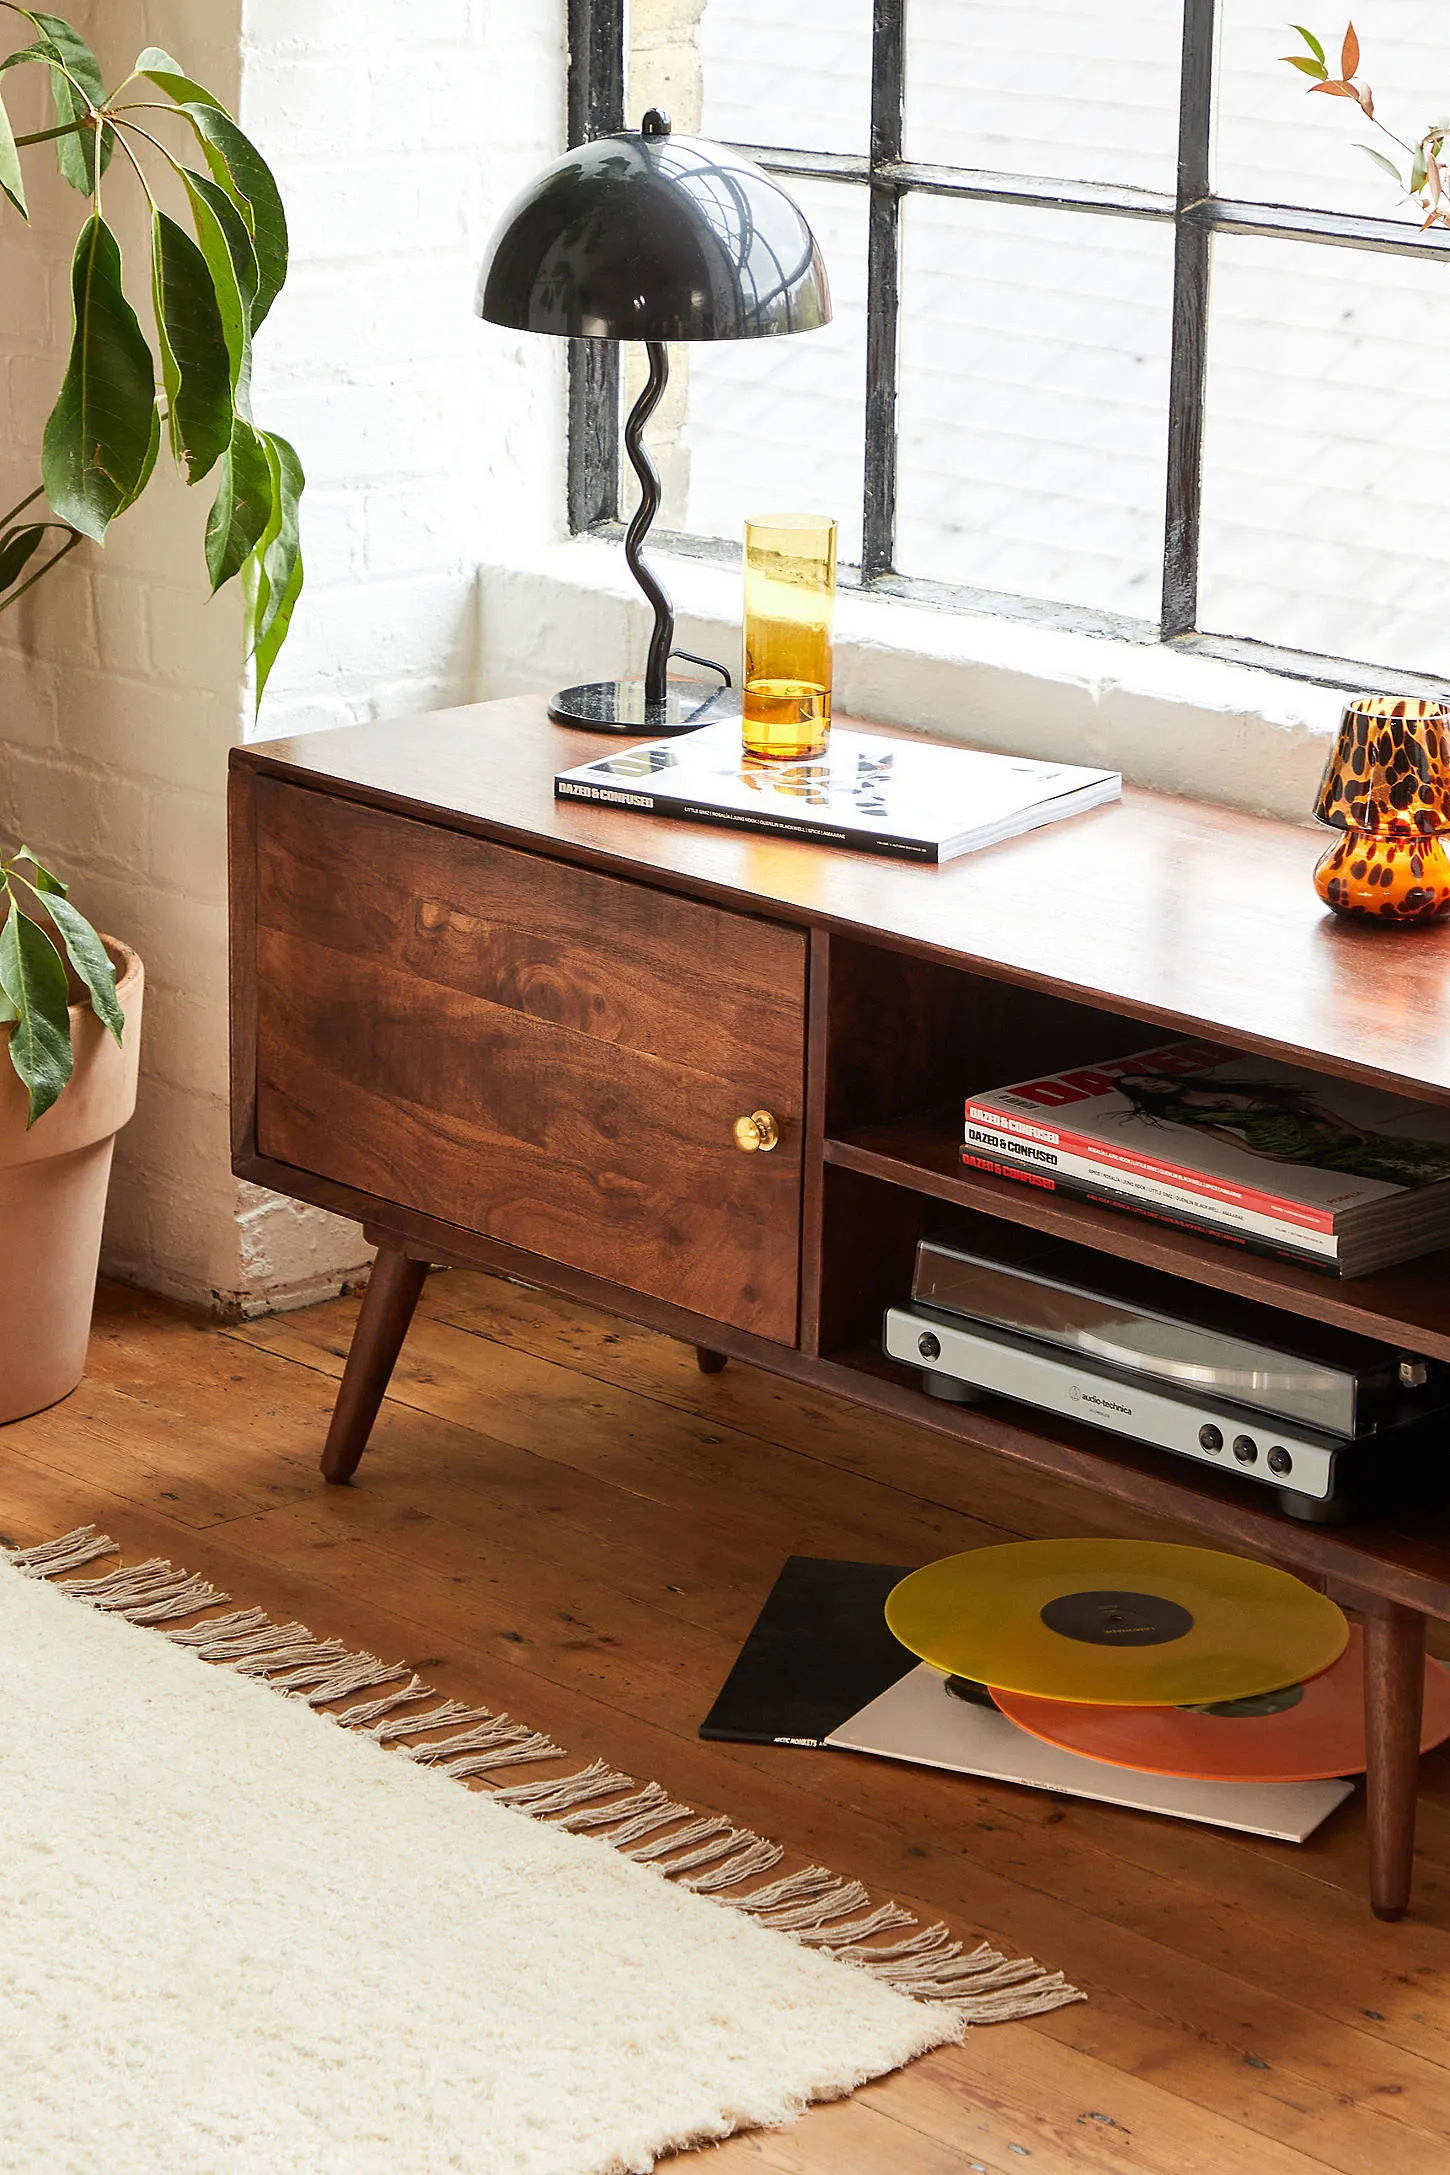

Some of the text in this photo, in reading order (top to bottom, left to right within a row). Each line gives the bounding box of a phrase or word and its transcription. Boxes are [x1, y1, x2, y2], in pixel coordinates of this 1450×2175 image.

[558, 782, 654, 808] DAZED & CONFUSED
[969, 1106, 1060, 1145] DAZED & CONFUSED
[968, 1129, 1058, 1166] DAZED & CONFUSED
[962, 1153, 1056, 1190] DAZED & CONFUSED
[1081, 1393, 1132, 1416] audio-technica
